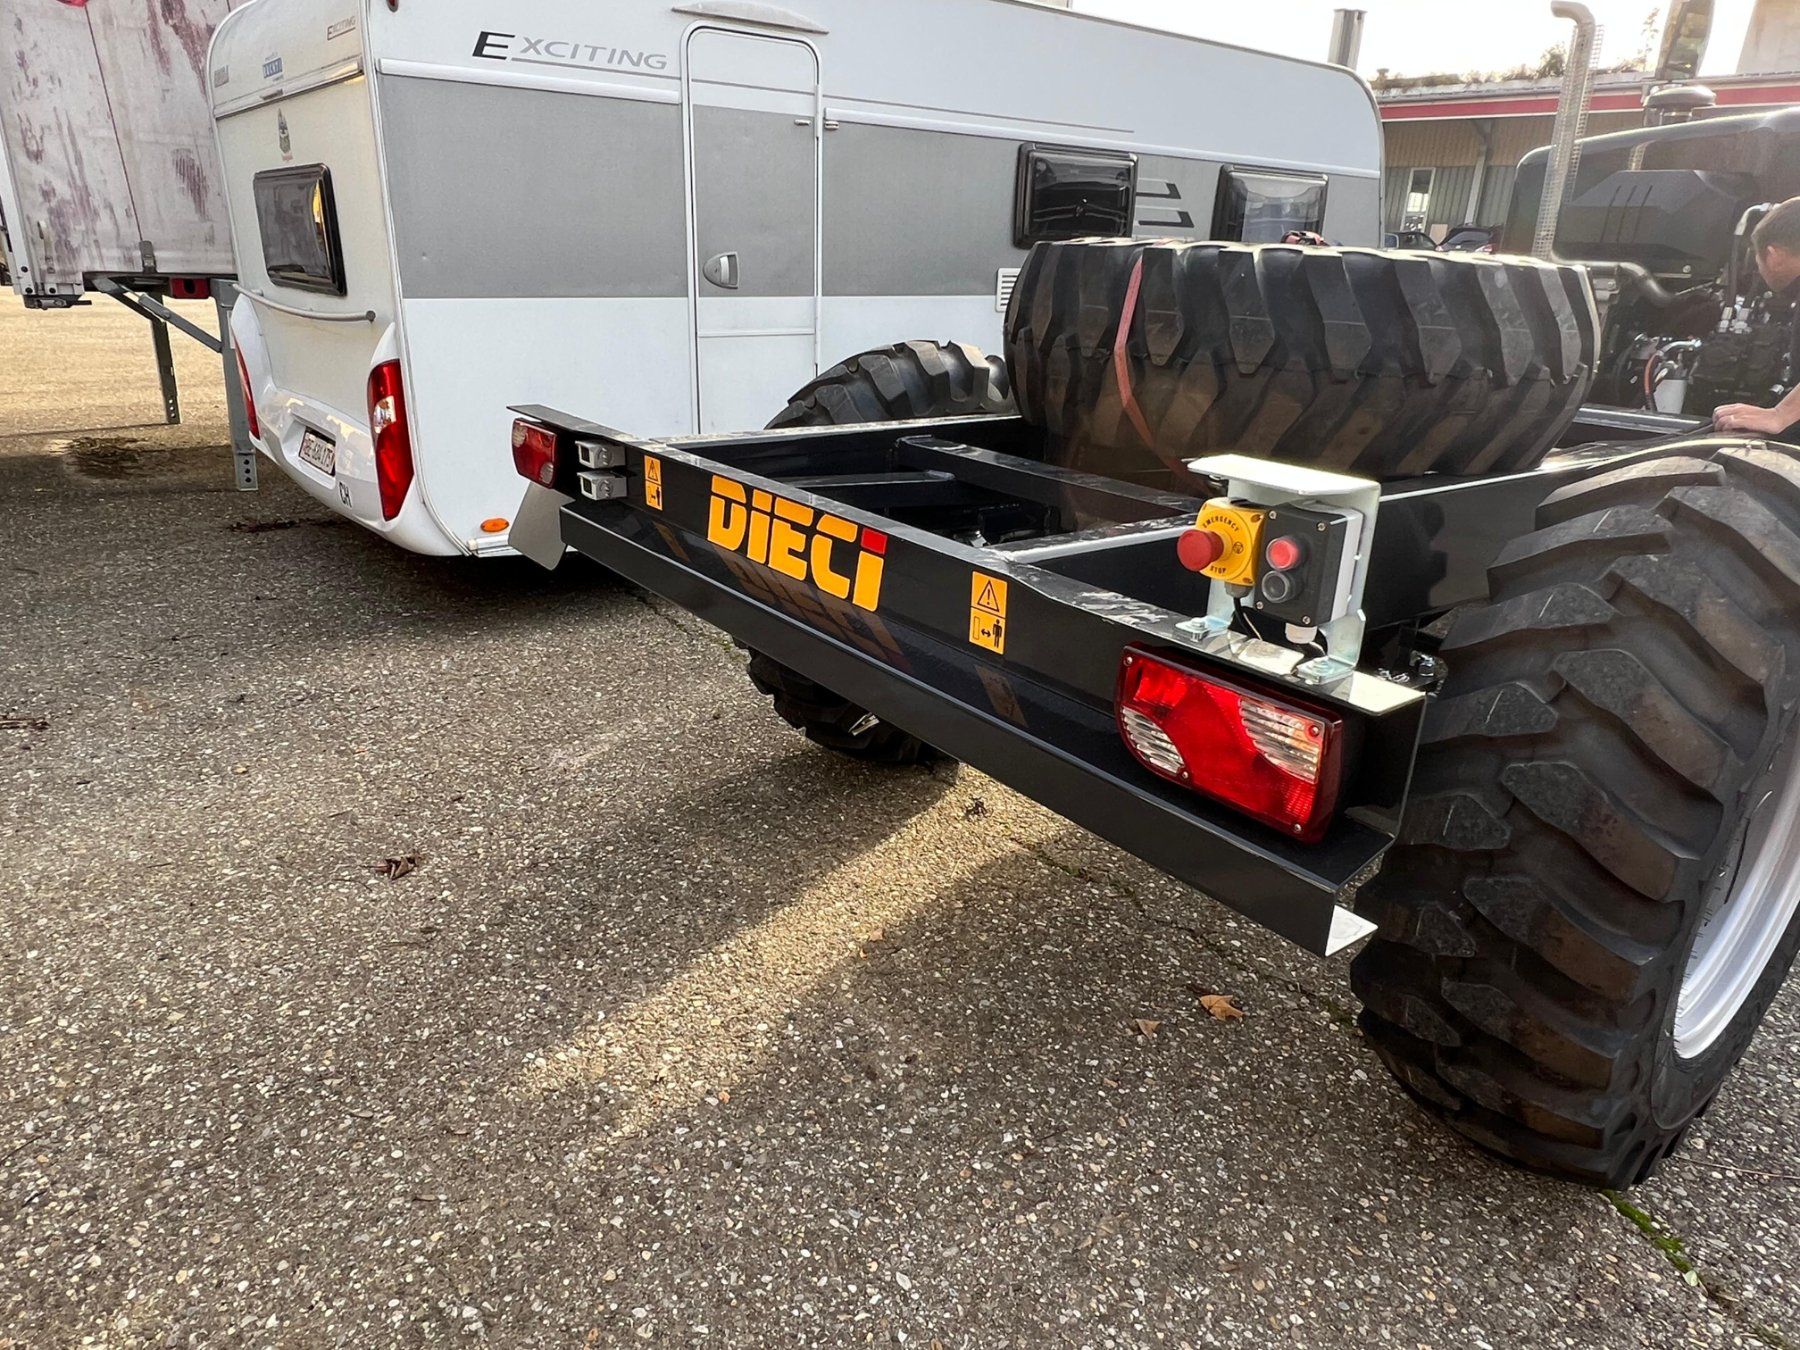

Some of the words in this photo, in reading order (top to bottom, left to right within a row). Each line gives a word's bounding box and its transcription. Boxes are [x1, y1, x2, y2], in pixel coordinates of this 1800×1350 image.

[472, 31, 668, 70] EXCITING
[339, 481, 352, 508] CH
[1202, 515, 1239, 532] EMERGENCY
[1210, 565, 1226, 574] STOP
